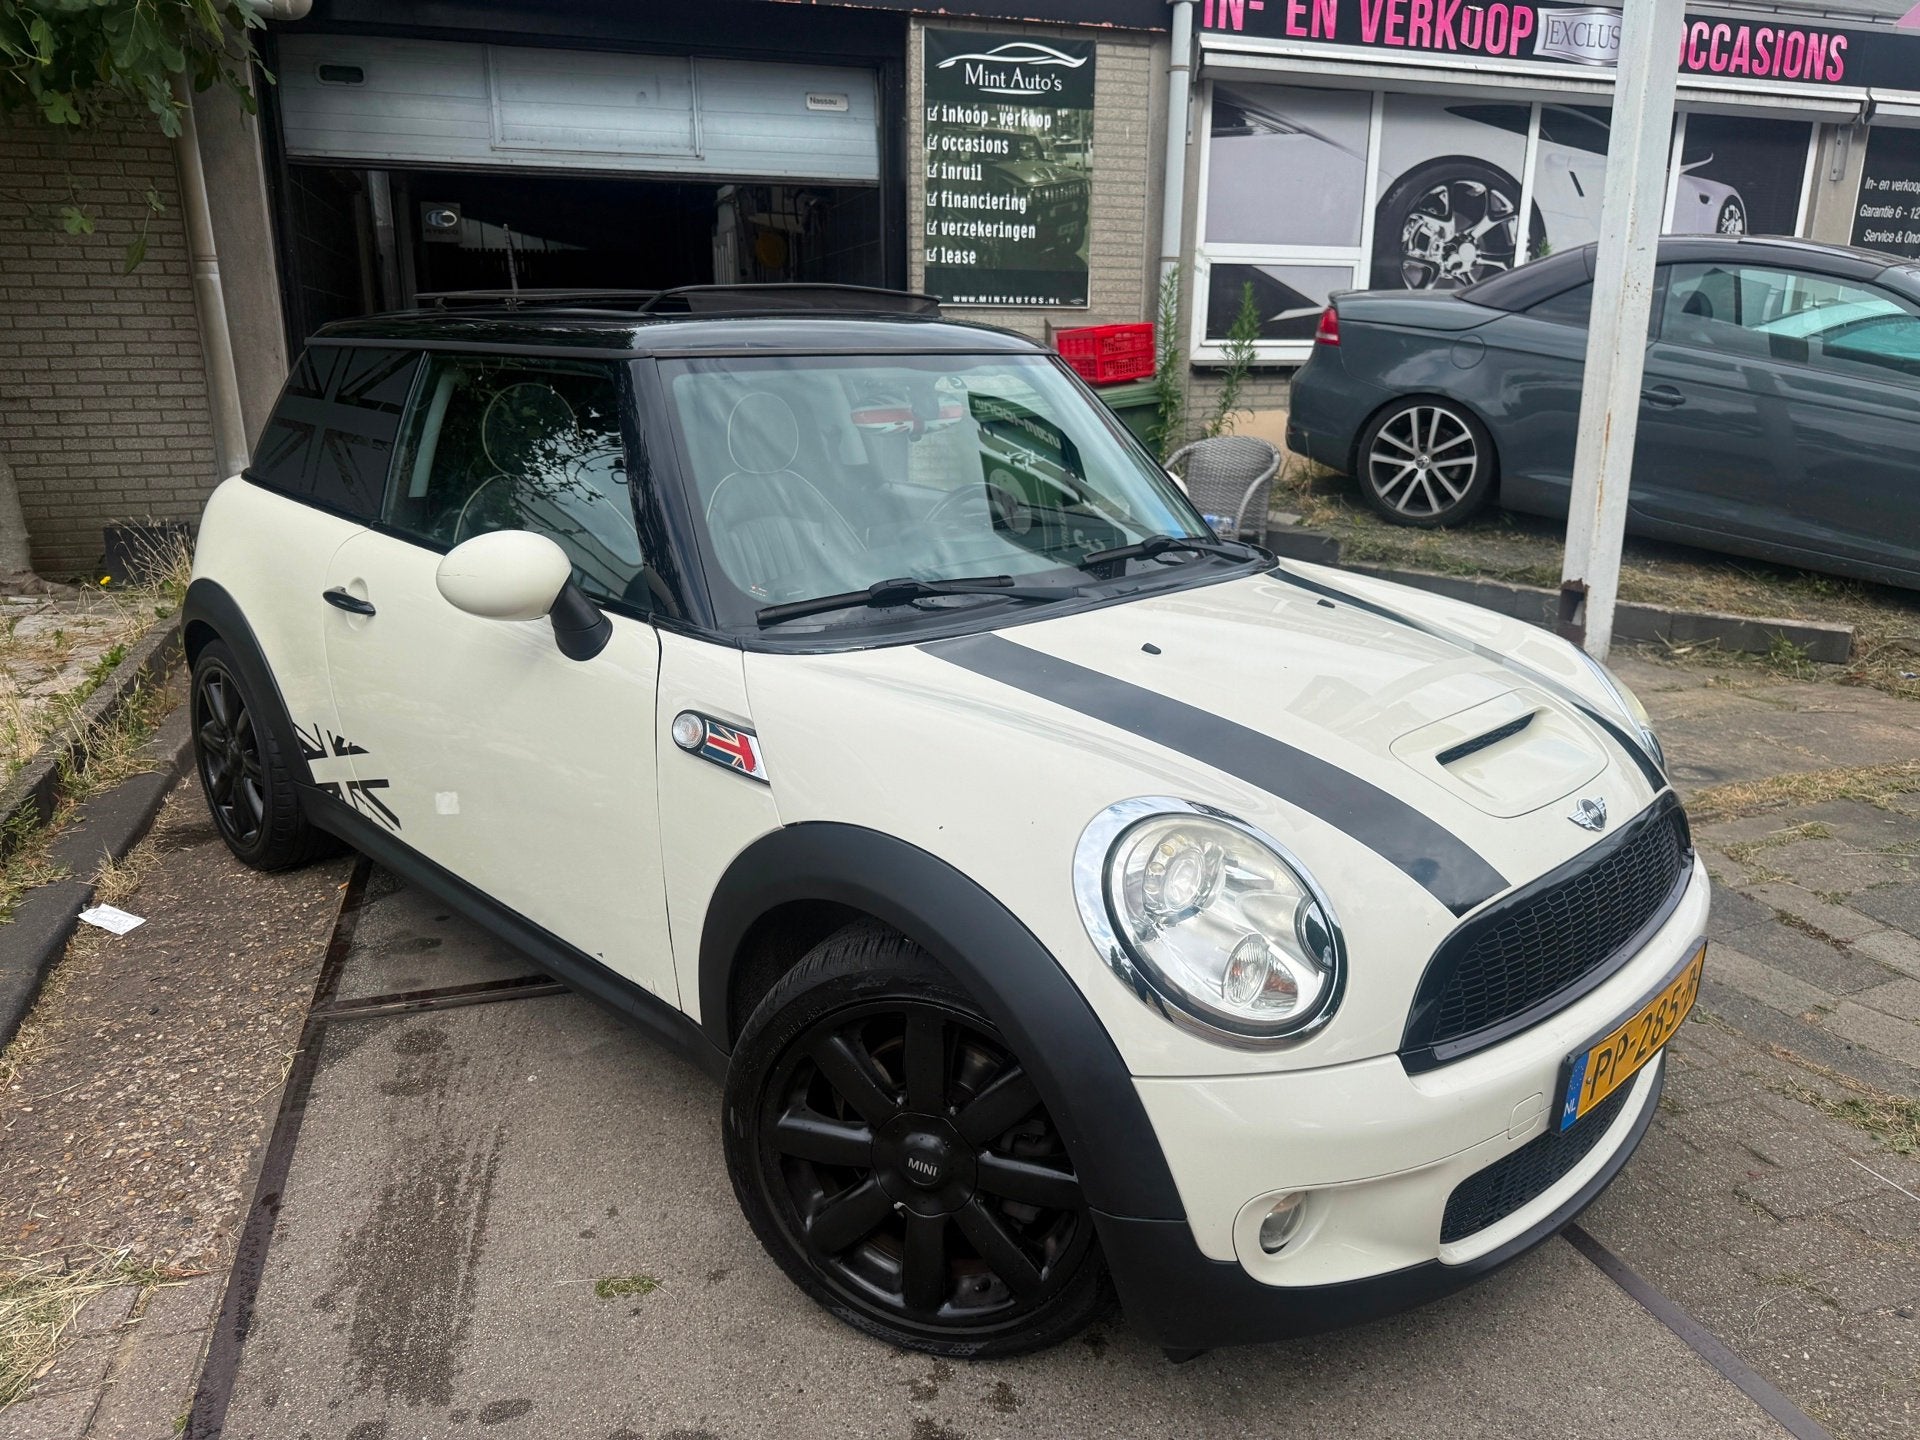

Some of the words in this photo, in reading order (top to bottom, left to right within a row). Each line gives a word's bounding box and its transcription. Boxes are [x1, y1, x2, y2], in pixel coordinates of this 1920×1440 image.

[1286, 0, 1338, 39] EN
[1550, 19, 1622, 50] EXCLUS
[965, 63, 1007, 88] Mint
[1010, 67, 1063, 92] Auto's
[941, 135, 1009, 155] occasions
[941, 162, 982, 181] inruil
[1879, 180, 1890, 191] en
[941, 190, 1027, 214] financiering
[1860, 203, 1895, 219] Garantie
[1895, 205, 1903, 219] 6
[940, 219, 1036, 242] verzekeringen
[1863, 228, 1895, 243] Service
[1895, 230, 1903, 243] &
[940, 247, 977, 265] lease
[1563, 1096, 1577, 1118] NL
[907, 1157, 938, 1177] MINI
